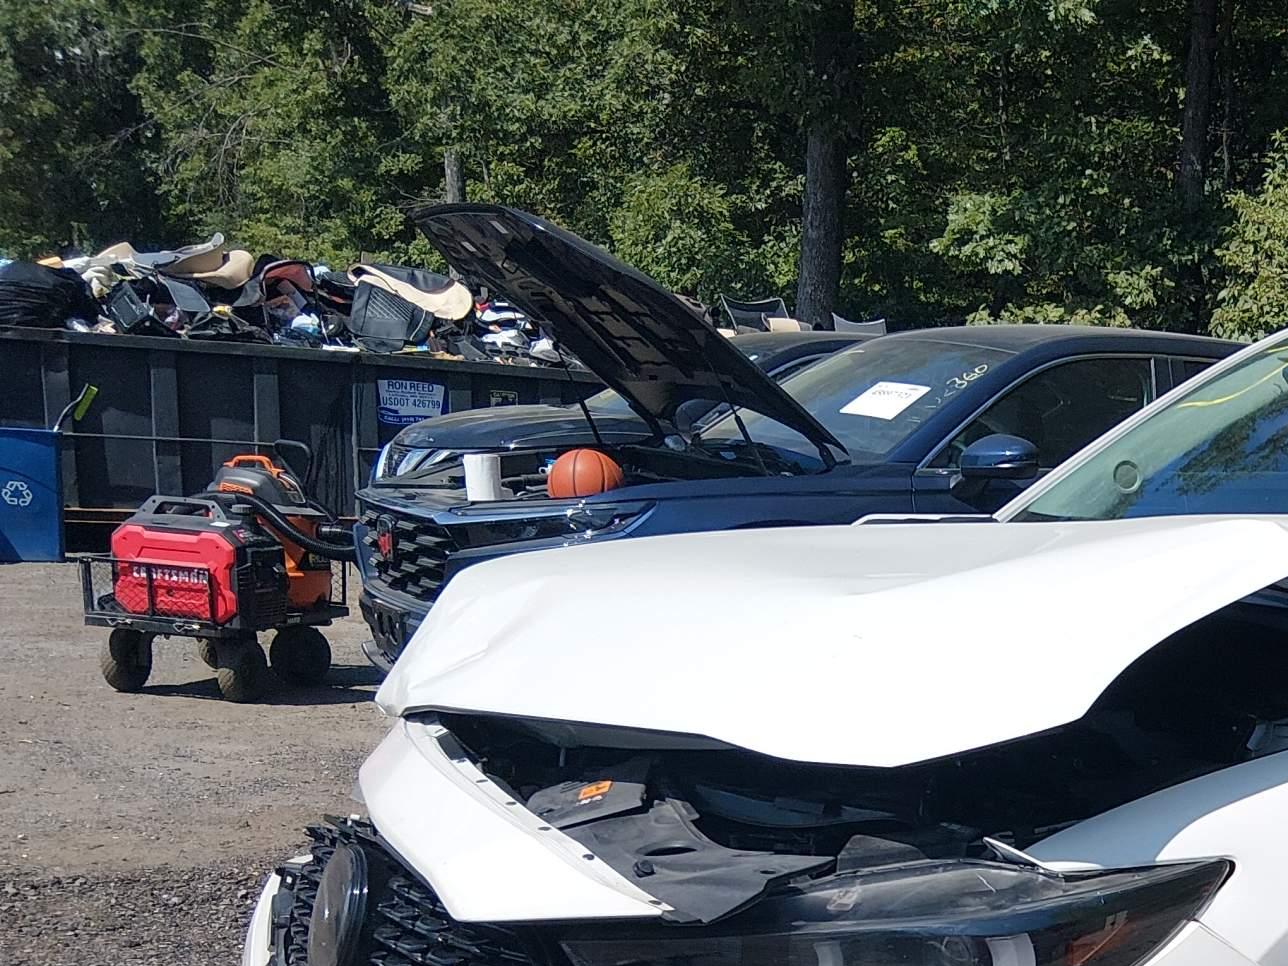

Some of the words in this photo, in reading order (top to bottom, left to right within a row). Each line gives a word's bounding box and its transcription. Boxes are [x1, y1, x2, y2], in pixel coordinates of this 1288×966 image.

[946, 364, 988, 389] 360
[387, 380, 408, 391] RON
[409, 382, 434, 393] REED
[382, 396, 410, 407] USDOT
[411, 398, 441, 409] 426799
